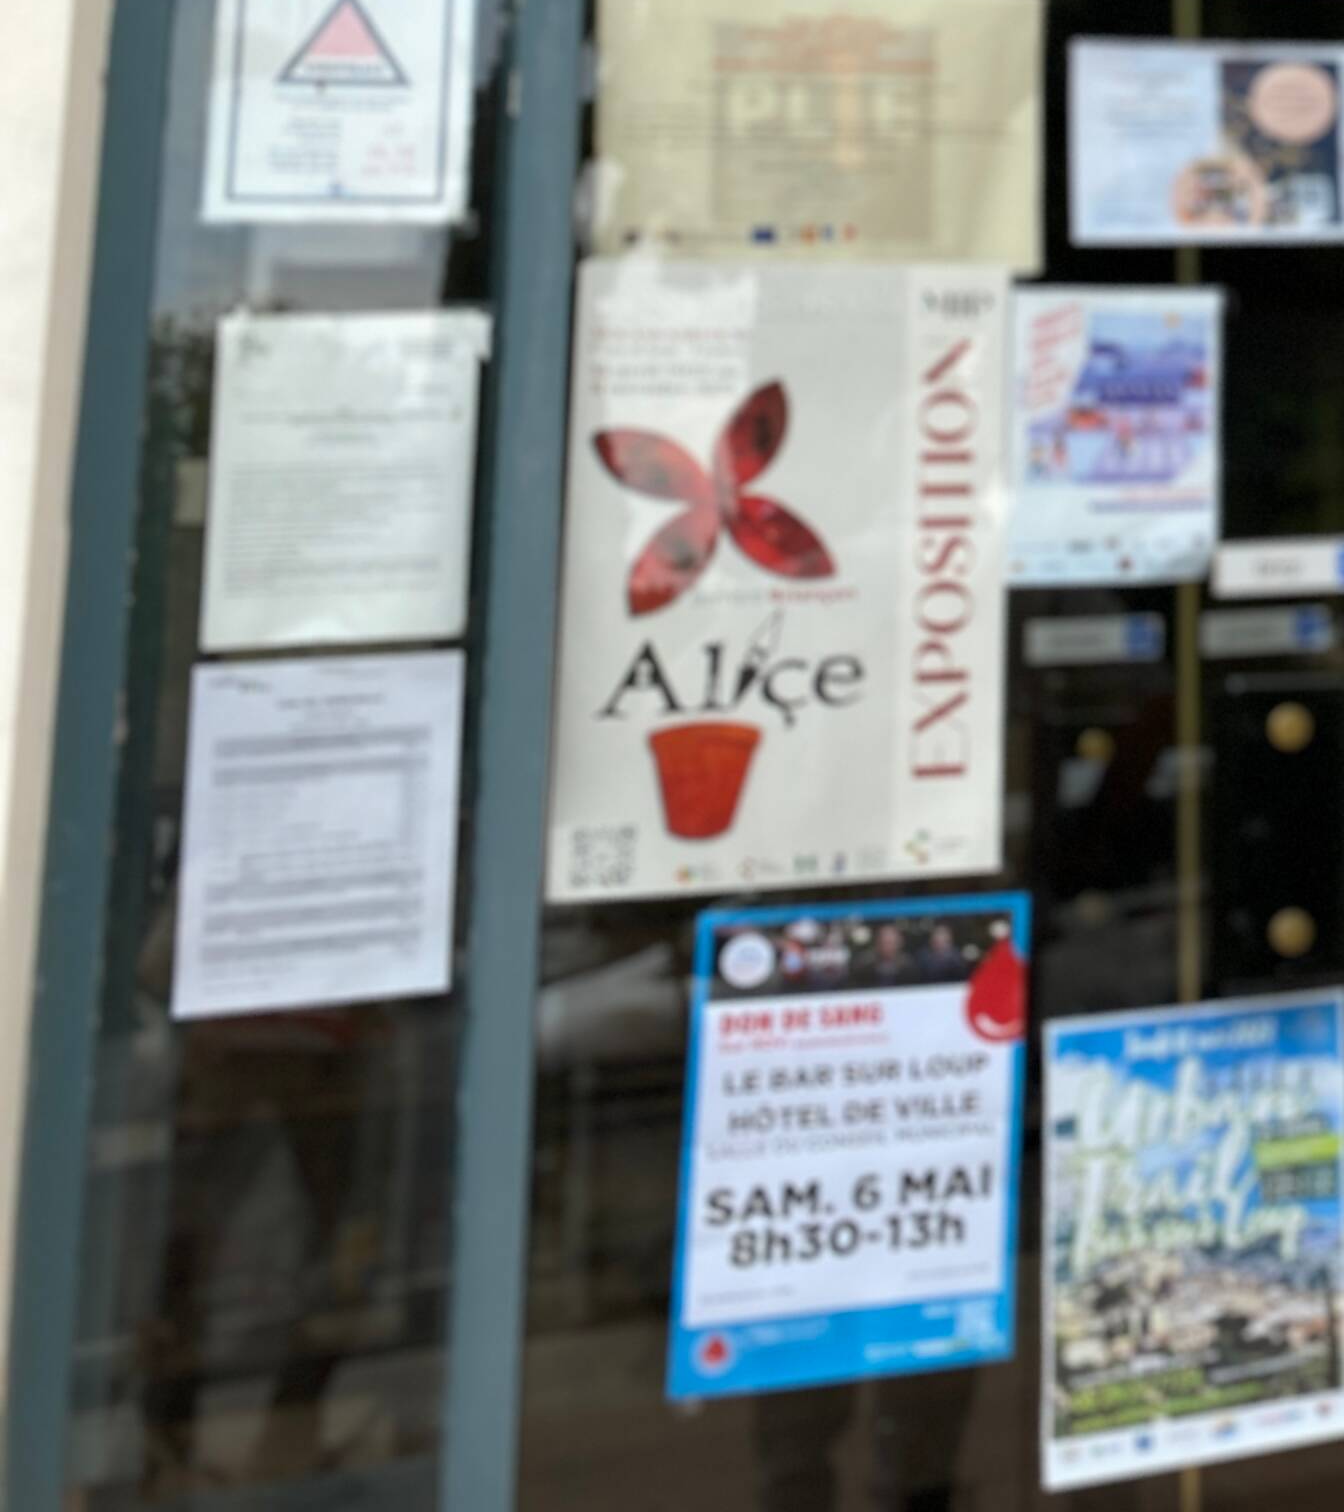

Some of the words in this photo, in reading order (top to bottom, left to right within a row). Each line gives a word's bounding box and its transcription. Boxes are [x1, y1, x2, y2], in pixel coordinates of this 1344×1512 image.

[910, 338, 980, 781] EXPOSITION
[724, 1071, 762, 1097] LE
[770, 1065, 832, 1092] BAR
[843, 1059, 901, 1085] SUR
[911, 1053, 987, 1079] LOUP
[730, 1099, 832, 1134] HÔTEL
[842, 1098, 886, 1126] DE
[896, 1092, 980, 1119] VILLE
[705, 1184, 835, 1227] SAM.
[852, 1176, 882, 1212] 6
[900, 1165, 994, 1206] MAI
[730, 1211, 966, 1269] 8h30-13h
